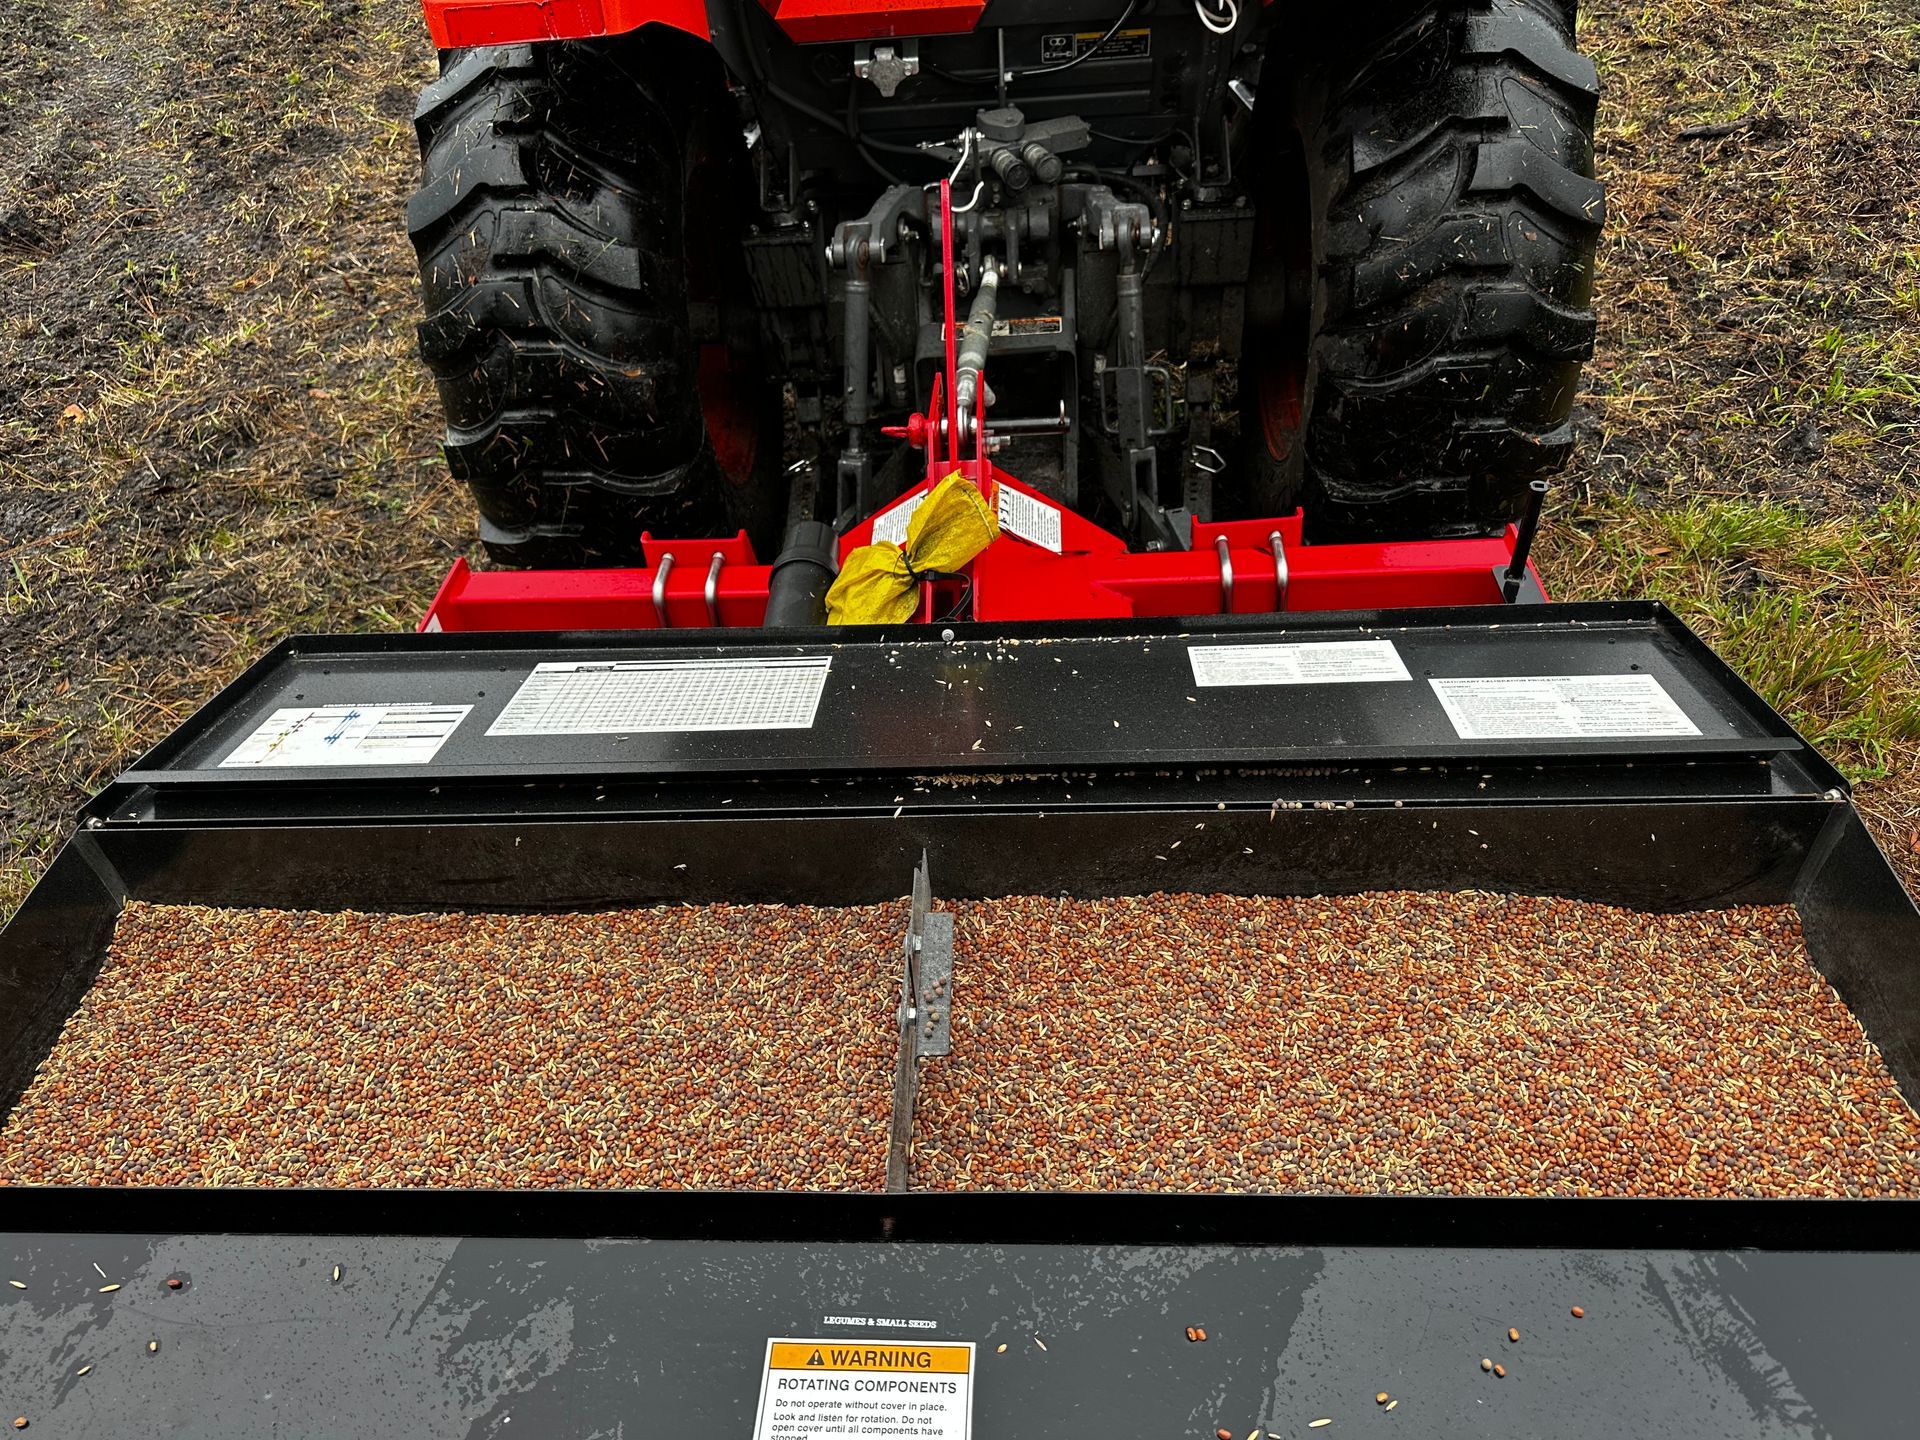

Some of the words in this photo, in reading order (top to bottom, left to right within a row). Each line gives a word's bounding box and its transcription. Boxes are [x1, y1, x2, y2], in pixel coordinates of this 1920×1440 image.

[823, 1316, 866, 1326] LEGUMES
[867, 1318, 875, 1326] &
[876, 1318, 907, 1327] SMALL
[908, 1320, 937, 1329] SEEDS
[830, 1349, 931, 1368] WARNING
[778, 1378, 850, 1391] ROTATING
[854, 1379, 957, 1394] COMPONENTS
[775, 1398, 788, 1407] Do
[807, 1400, 842, 1409] operate
[845, 1401, 878, 1409] without
[881, 1402, 906, 1410] cover
[908, 1402, 917, 1410] in
[919, 1402, 947, 1412] place.
[773, 1412, 796, 1421] Look
[798, 1413, 816, 1421] and
[818, 1413, 843, 1422] listen
[845, 1414, 858, 1423] for
[860, 1415, 899, 1423] rotation.
[901, 1415, 915, 1424] Do
[772, 1424, 795, 1433] open
[825, 1424, 846, 1433] until
[848, 1425, 859, 1433] all
[861, 1426, 919, 1436] components
[921, 1427, 944, 1436] have
